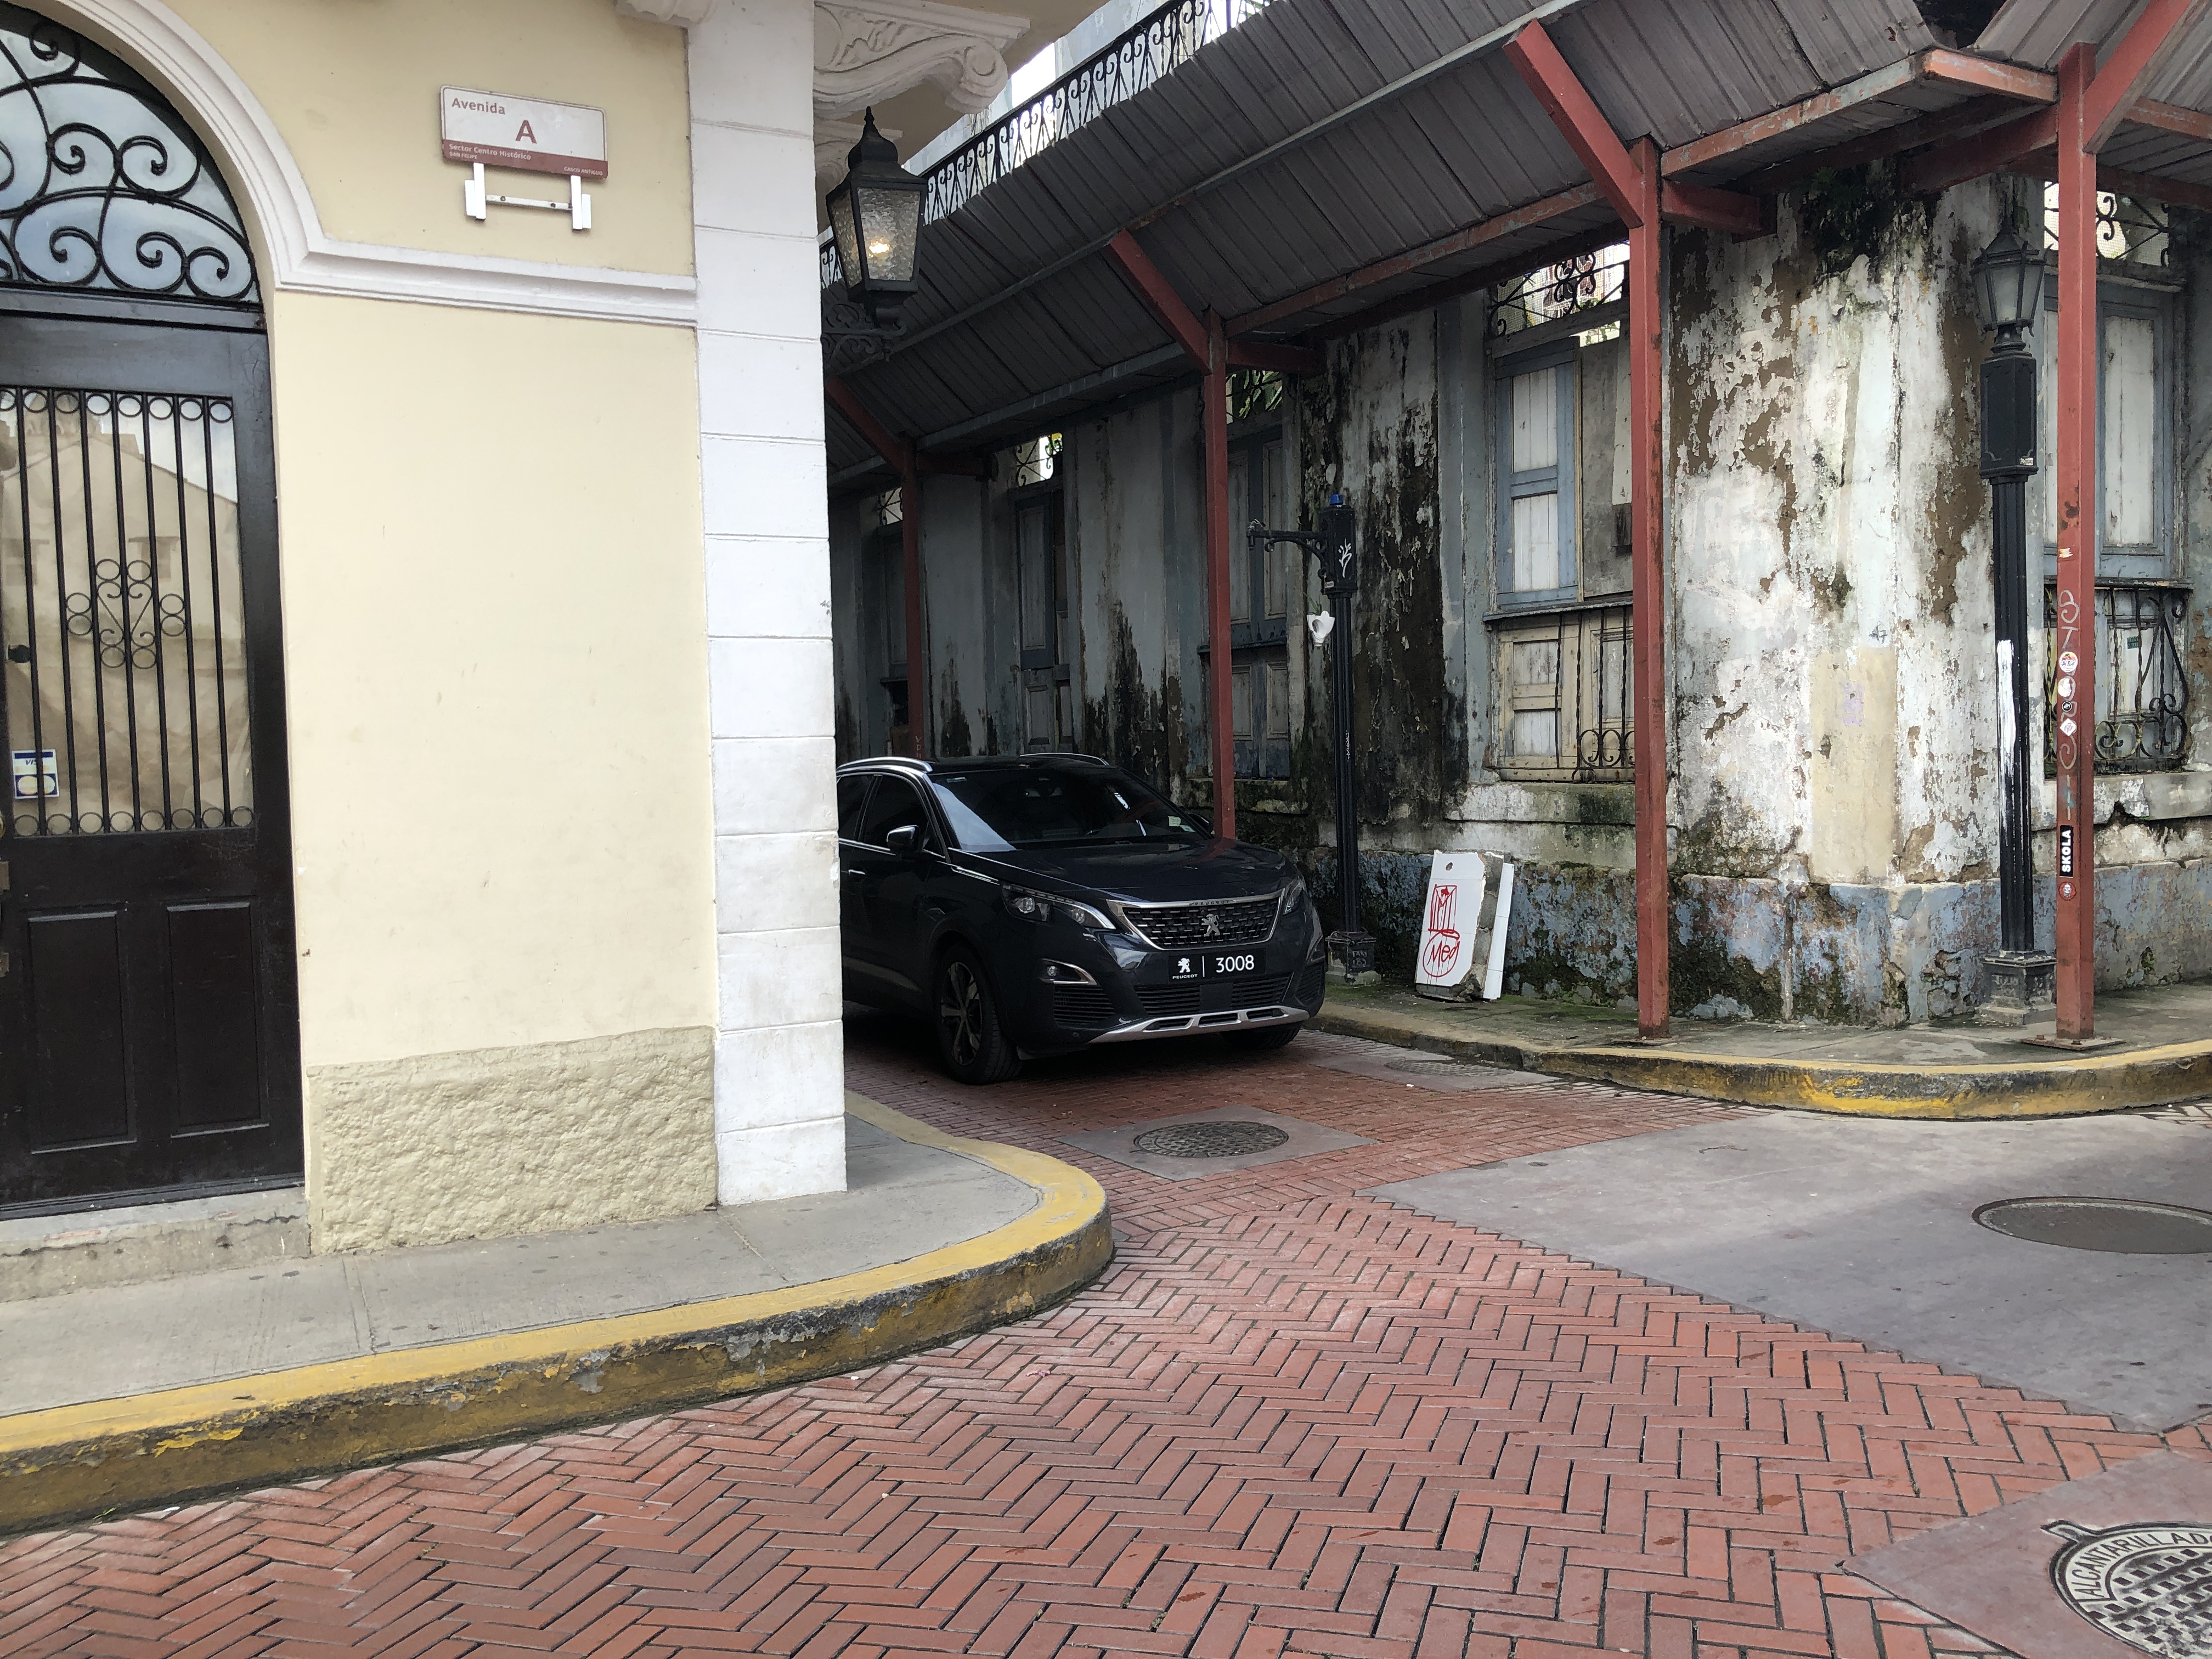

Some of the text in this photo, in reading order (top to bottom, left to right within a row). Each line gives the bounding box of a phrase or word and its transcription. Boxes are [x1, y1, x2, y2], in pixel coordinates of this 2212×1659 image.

[452, 98, 505, 115] Avenida
[515, 119, 537, 144] A
[449, 143, 532, 161] Sector Centro Histórico
[2062, 830, 2072, 873] SKOLA
[1216, 955, 1255, 973] 3008
